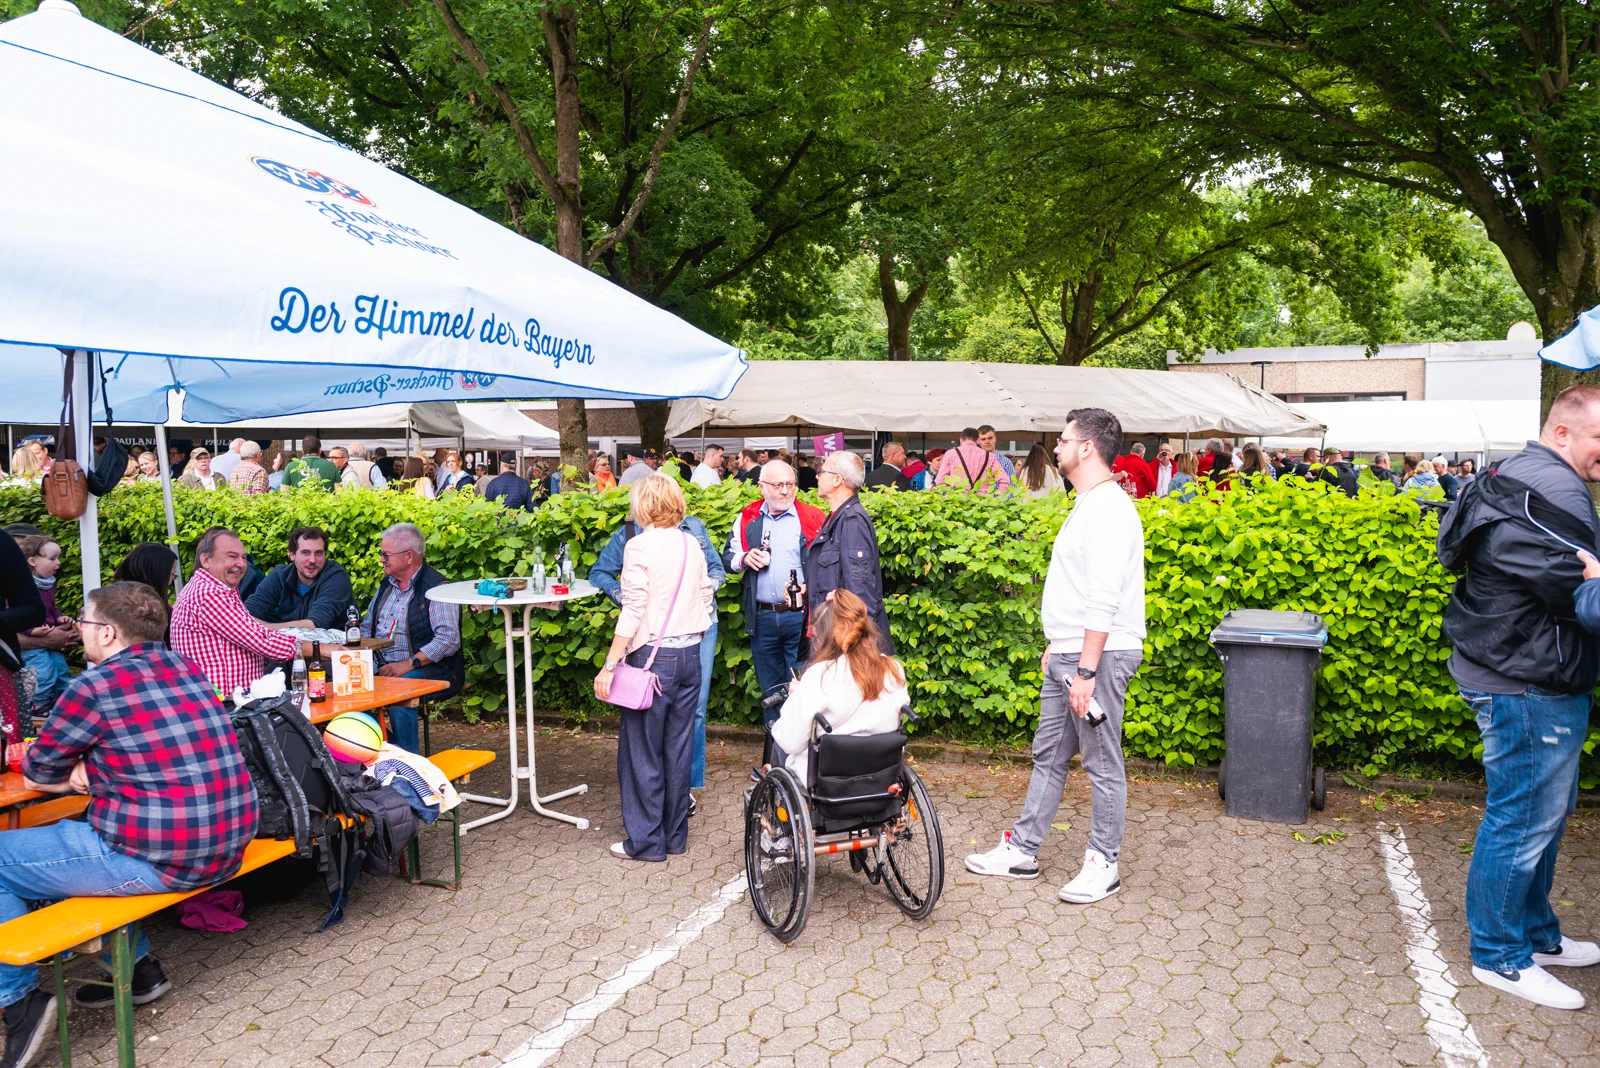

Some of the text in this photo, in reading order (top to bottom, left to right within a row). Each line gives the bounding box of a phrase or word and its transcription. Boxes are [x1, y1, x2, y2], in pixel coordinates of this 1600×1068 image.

[270, 286, 596, 369] Der Himmel der Bayern
